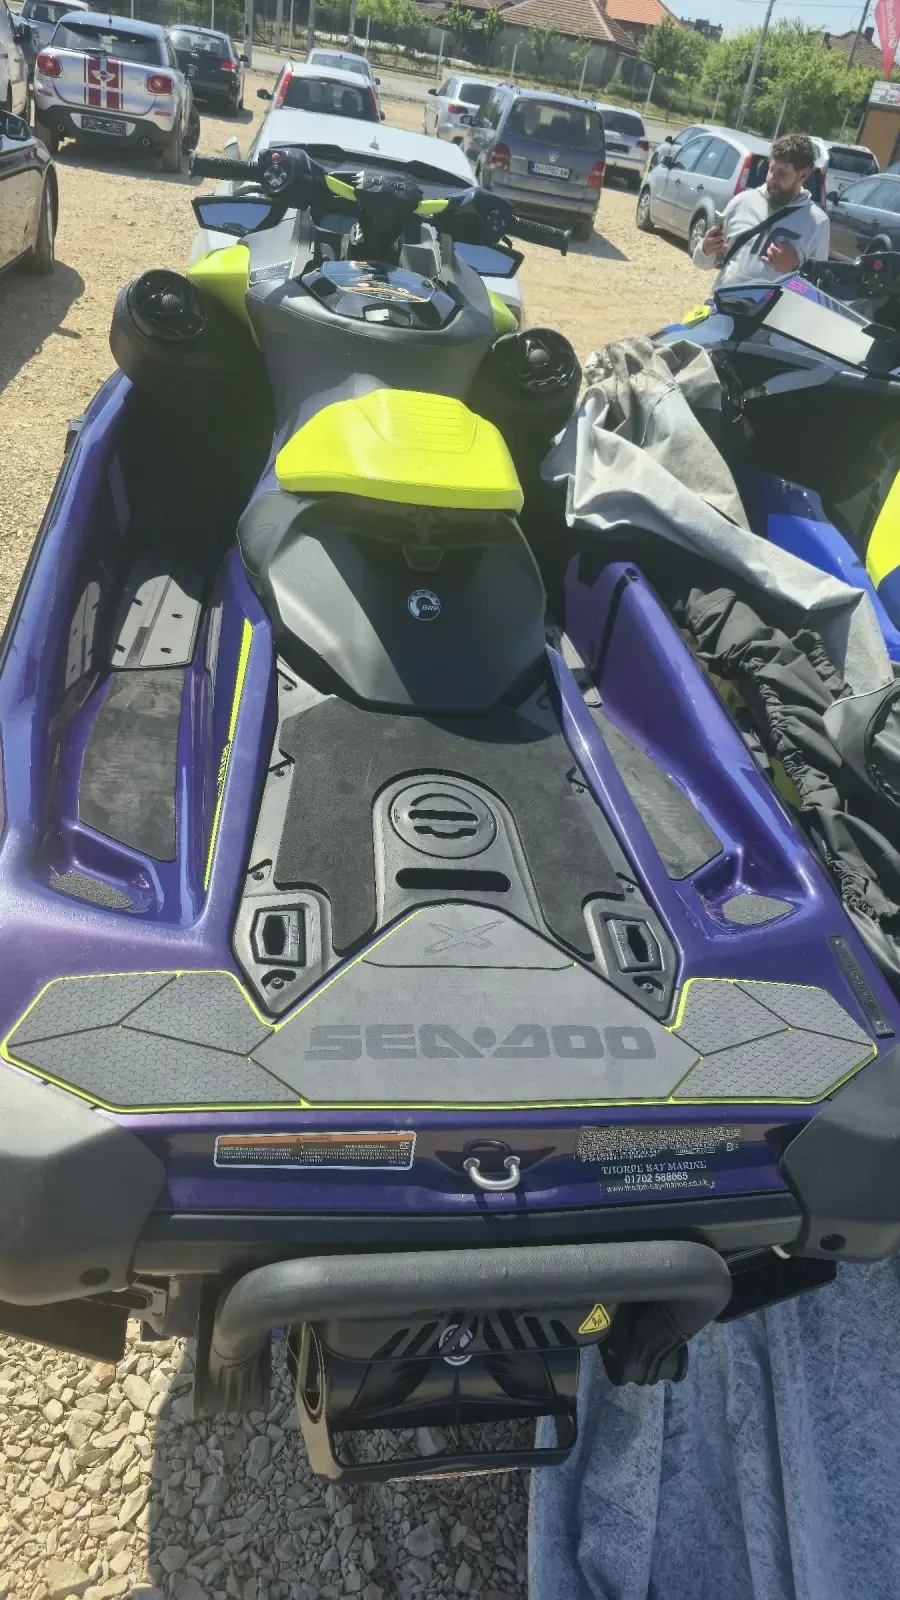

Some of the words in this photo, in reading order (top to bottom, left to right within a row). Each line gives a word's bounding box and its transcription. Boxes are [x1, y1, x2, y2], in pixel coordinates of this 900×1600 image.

[601, 1164, 644, 1175] THORPE
[646, 1163, 666, 1173] BAY
[667, 1160, 707, 1171] MARINE
[624, 1173, 653, 1184] 01702
[655, 1171, 689, 1182] 588065
